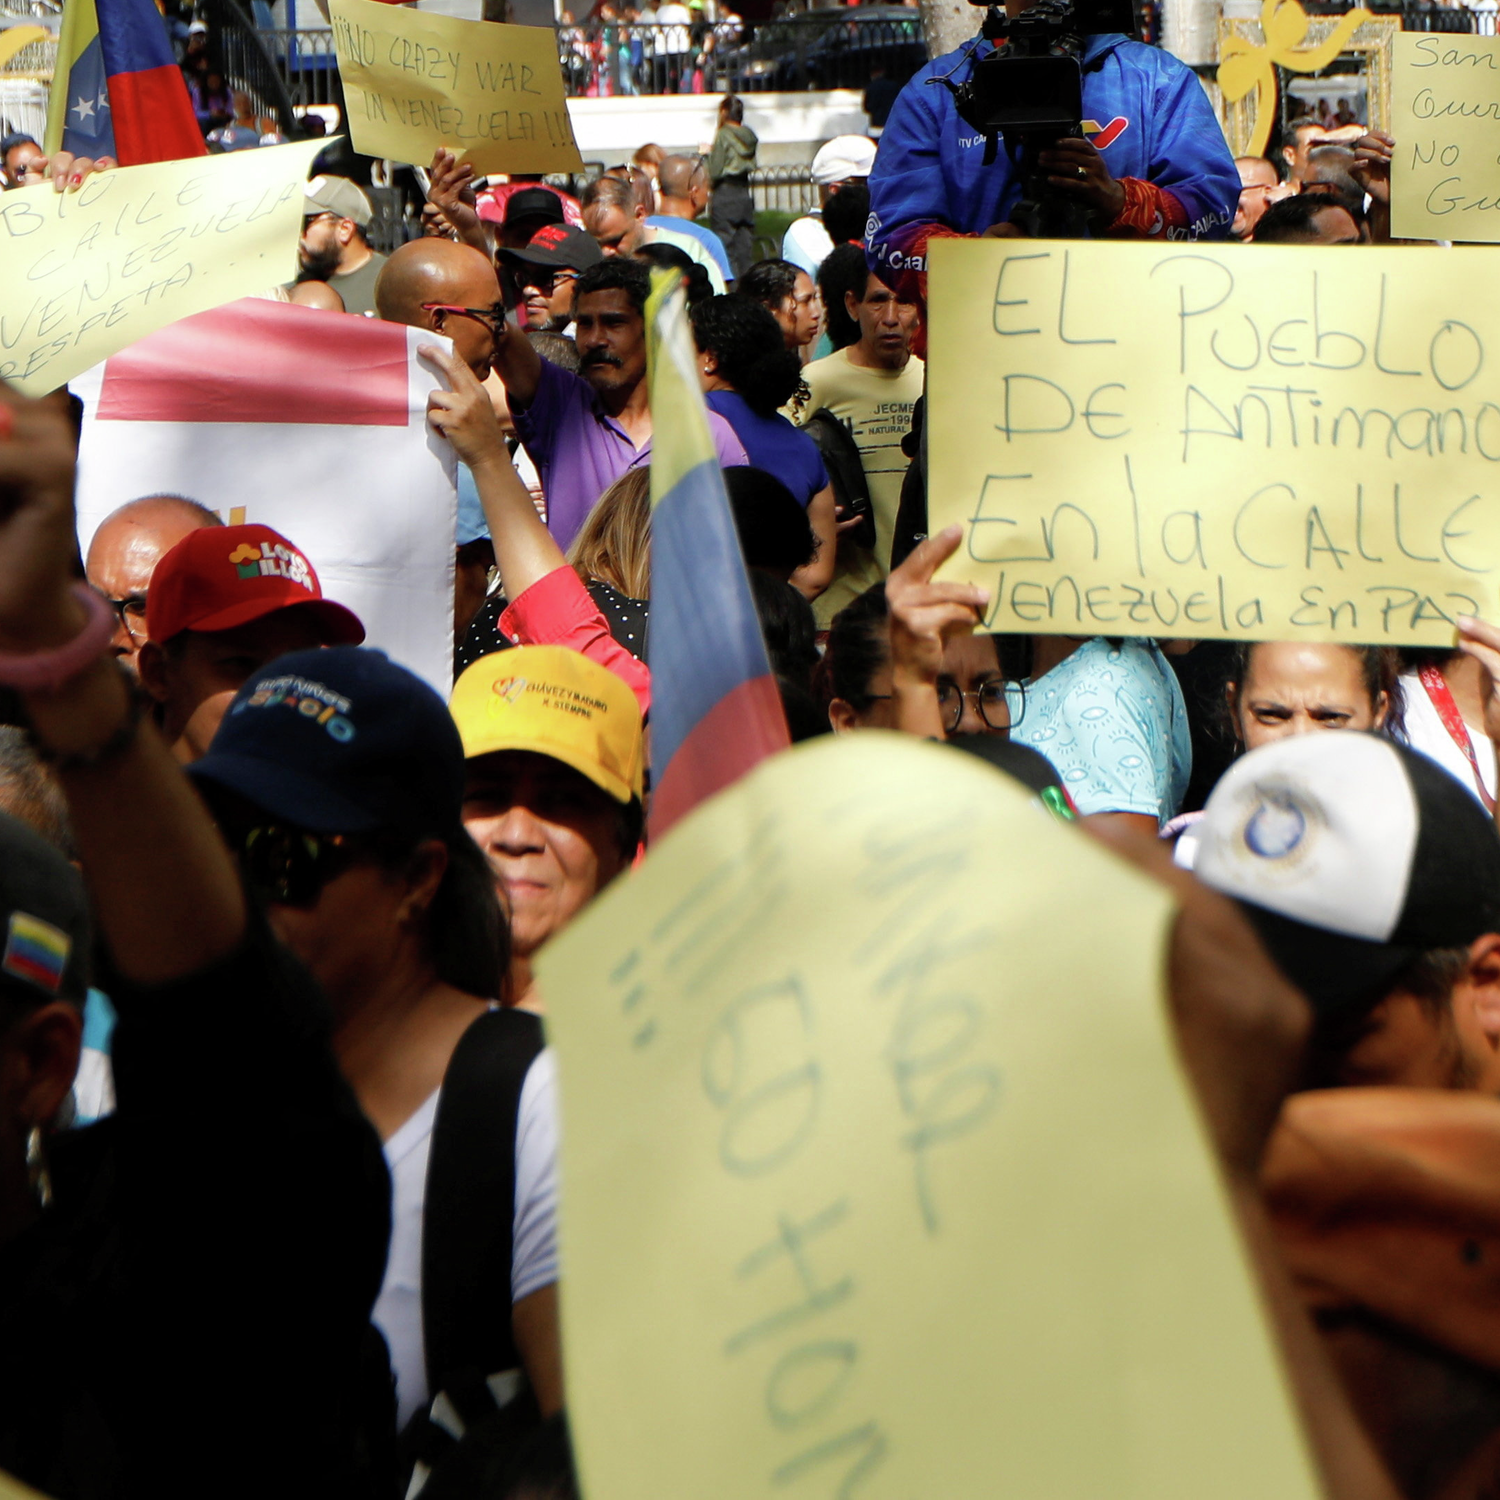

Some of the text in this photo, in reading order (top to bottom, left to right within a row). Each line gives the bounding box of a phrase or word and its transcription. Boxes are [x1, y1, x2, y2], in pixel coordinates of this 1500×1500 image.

[389, 37, 461, 90] CRAZY
[475, 62, 542, 95] WAR
[1410, 37, 1497, 69] San
[363, 90, 388, 123] IN
[0, 182, 298, 348] VENEZUELA
[992, 249, 1116, 345] EL
[873, 403, 915, 415] JECME
[890, 414, 912, 425] 199
[994, 373, 1131, 442] DE
[868, 425, 907, 436] NATURAL
